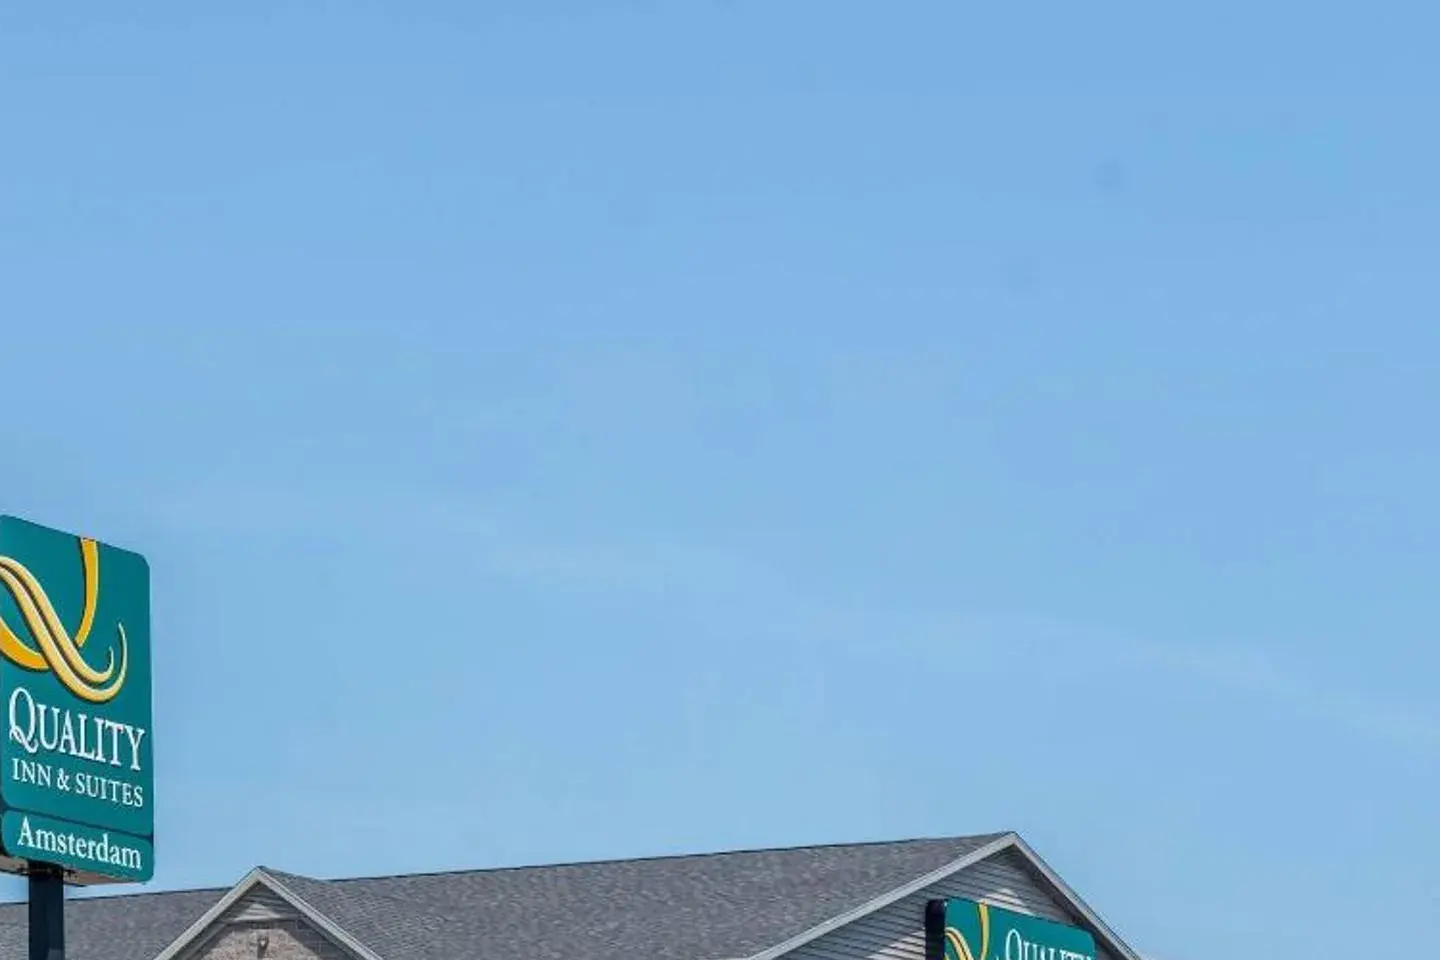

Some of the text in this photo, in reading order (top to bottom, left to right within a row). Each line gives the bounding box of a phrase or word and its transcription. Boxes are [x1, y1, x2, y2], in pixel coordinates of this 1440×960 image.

[8, 687, 145, 771] QUALITY
[12, 758, 143, 808] INN & SUITES
[17, 816, 142, 870] Amsterdam
